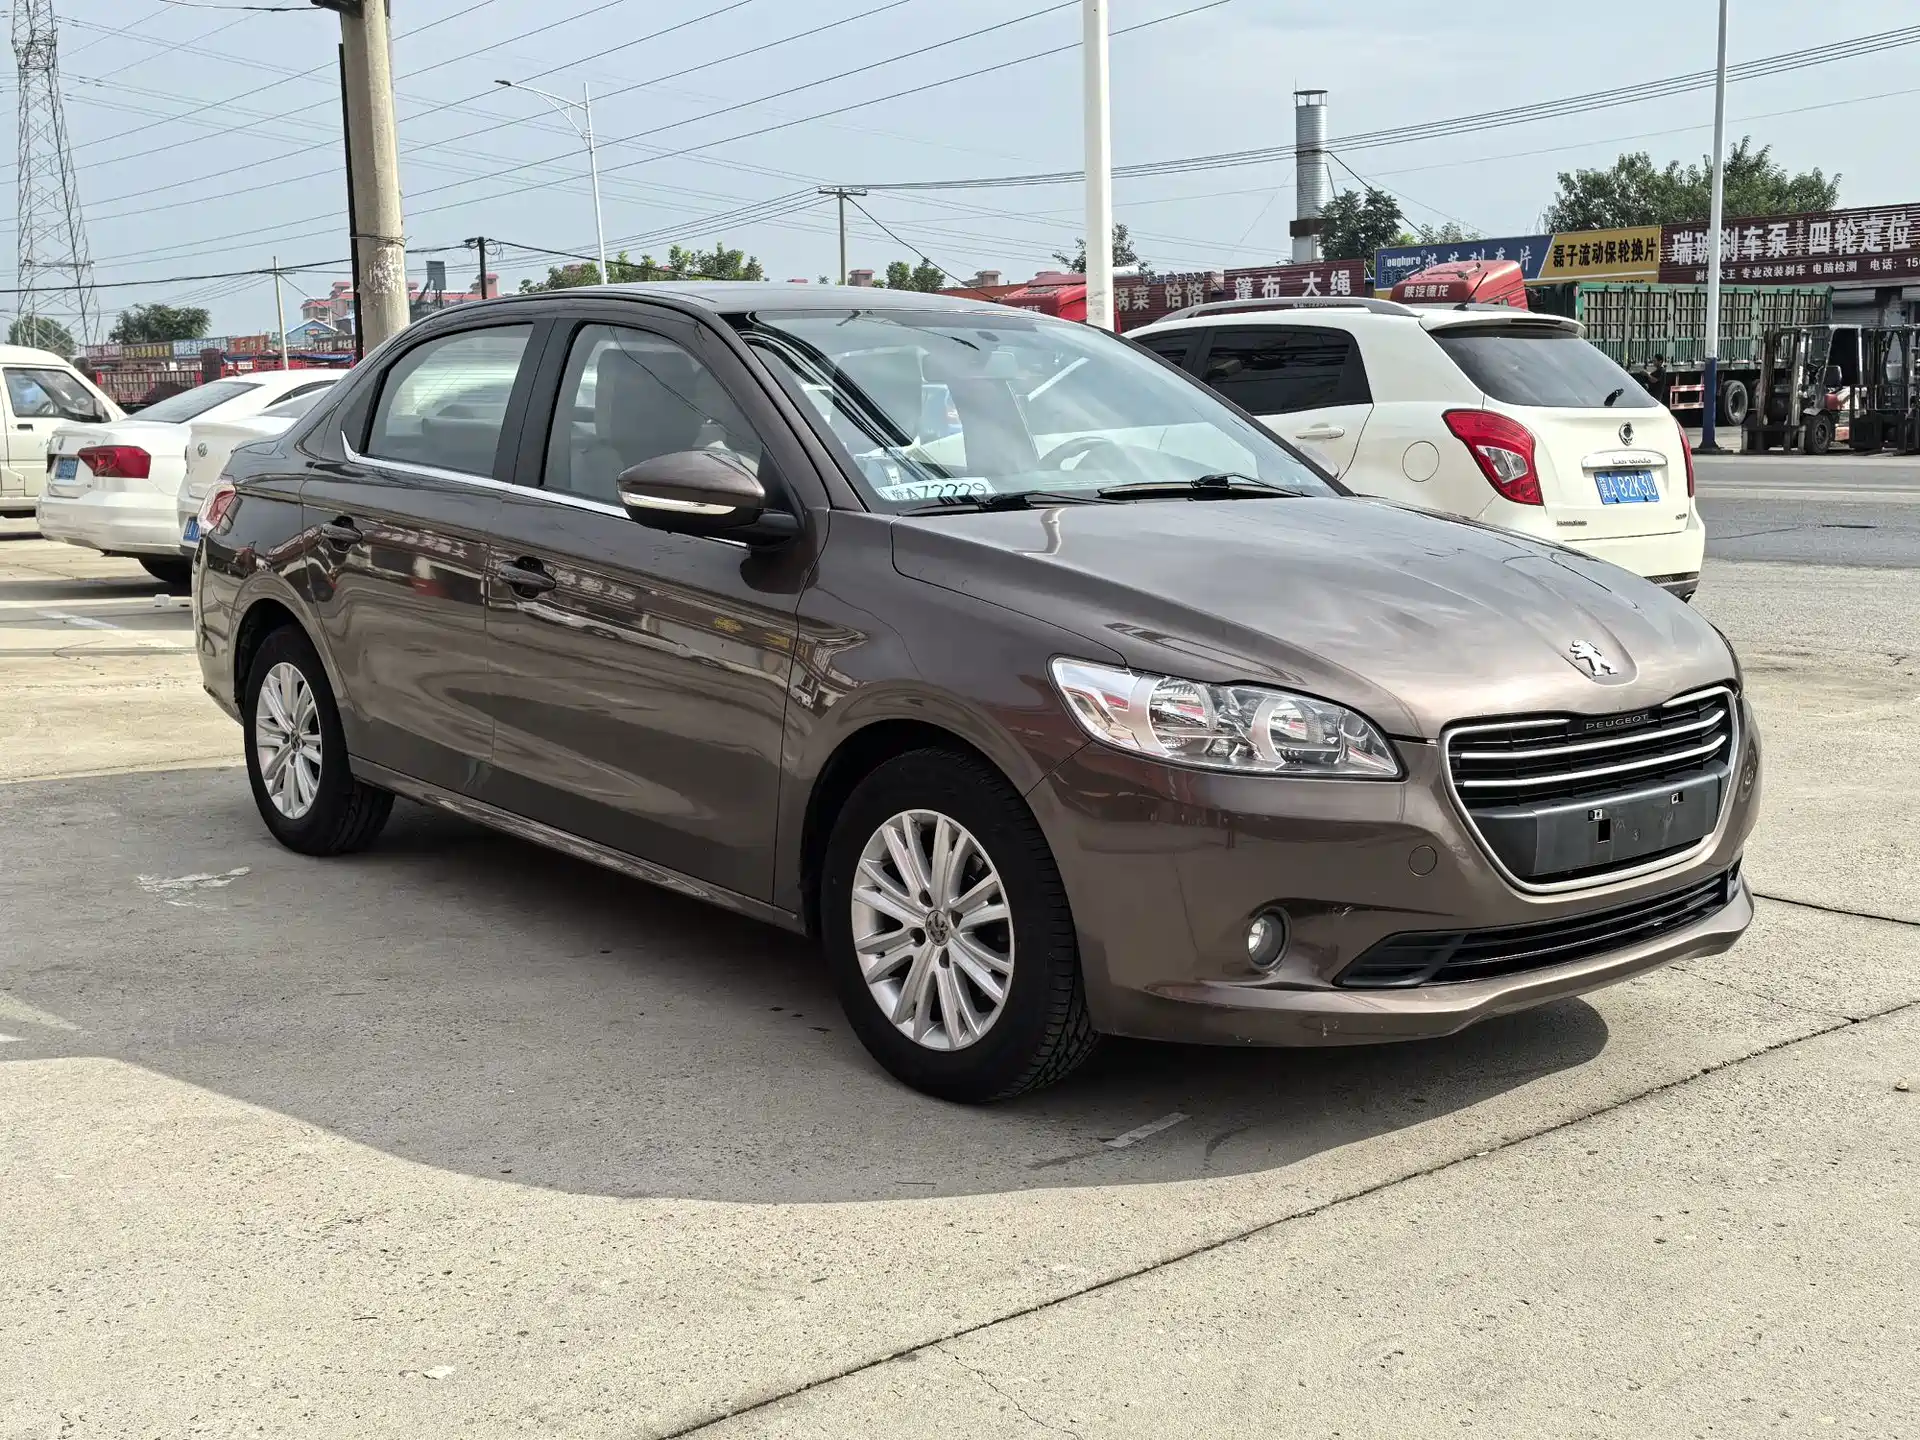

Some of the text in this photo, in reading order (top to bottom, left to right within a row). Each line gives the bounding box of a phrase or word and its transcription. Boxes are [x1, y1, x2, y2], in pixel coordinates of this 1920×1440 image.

[1809, 214, 1912, 255] 四轮定位
[1381, 254, 1421, 268] Toughpro
[1553, 237, 1656, 268] 磊子流动保轮换片
[1695, 269, 1736, 282] 刹大王
[1741, 264, 1806, 279] 专业改装刹车
[1812, 260, 1857, 275] 电脑检测
[1905, 257, 1920, 268] 15
[1234, 274, 1281, 300] 篷布
[1302, 269, 1352, 298] 大绳
[1404, 284, 1450, 299] 陕汽德龙
[1586, 713, 1649, 730] PEUGEOT
